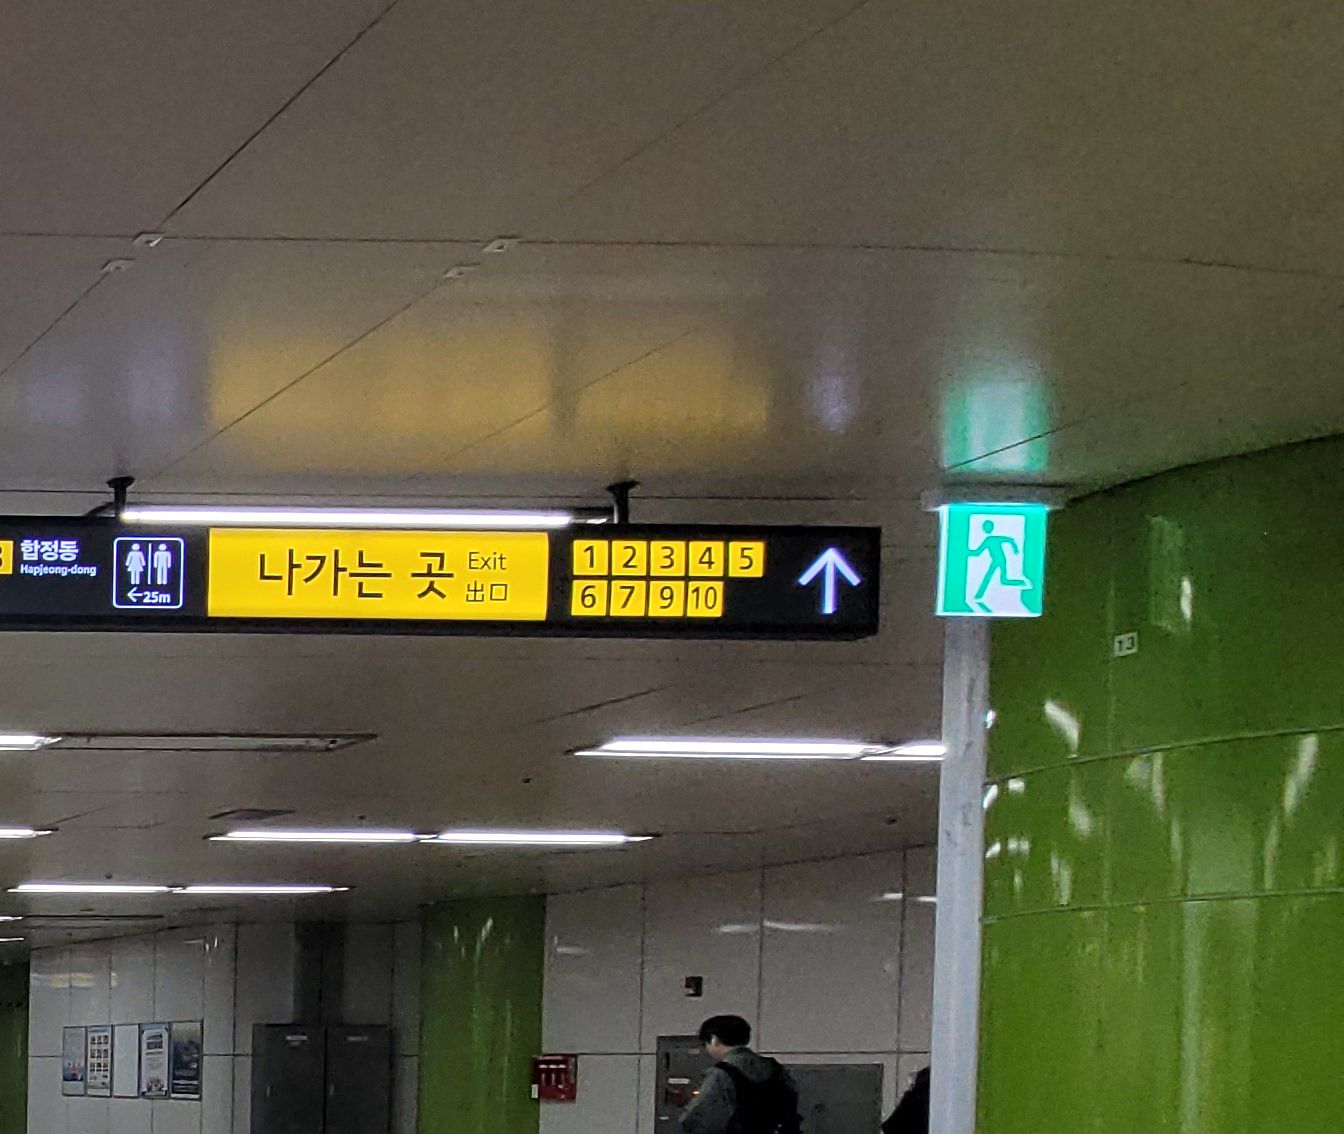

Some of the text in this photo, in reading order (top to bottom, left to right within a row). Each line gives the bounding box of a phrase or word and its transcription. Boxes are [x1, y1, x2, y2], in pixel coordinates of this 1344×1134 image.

[20, 539, 79, 561] 합정동
[468, 551, 507, 570] Exit
[583, 544, 754, 570] 1 2 3 4 5
[20, 564, 97, 576] Hapjeong-dong
[258, 548, 454, 600] 나가는 곳
[142, 590, 171, 604] 25m
[465, 580, 508, 603] 出口
[580, 584, 717, 610] 6 7 9 10
